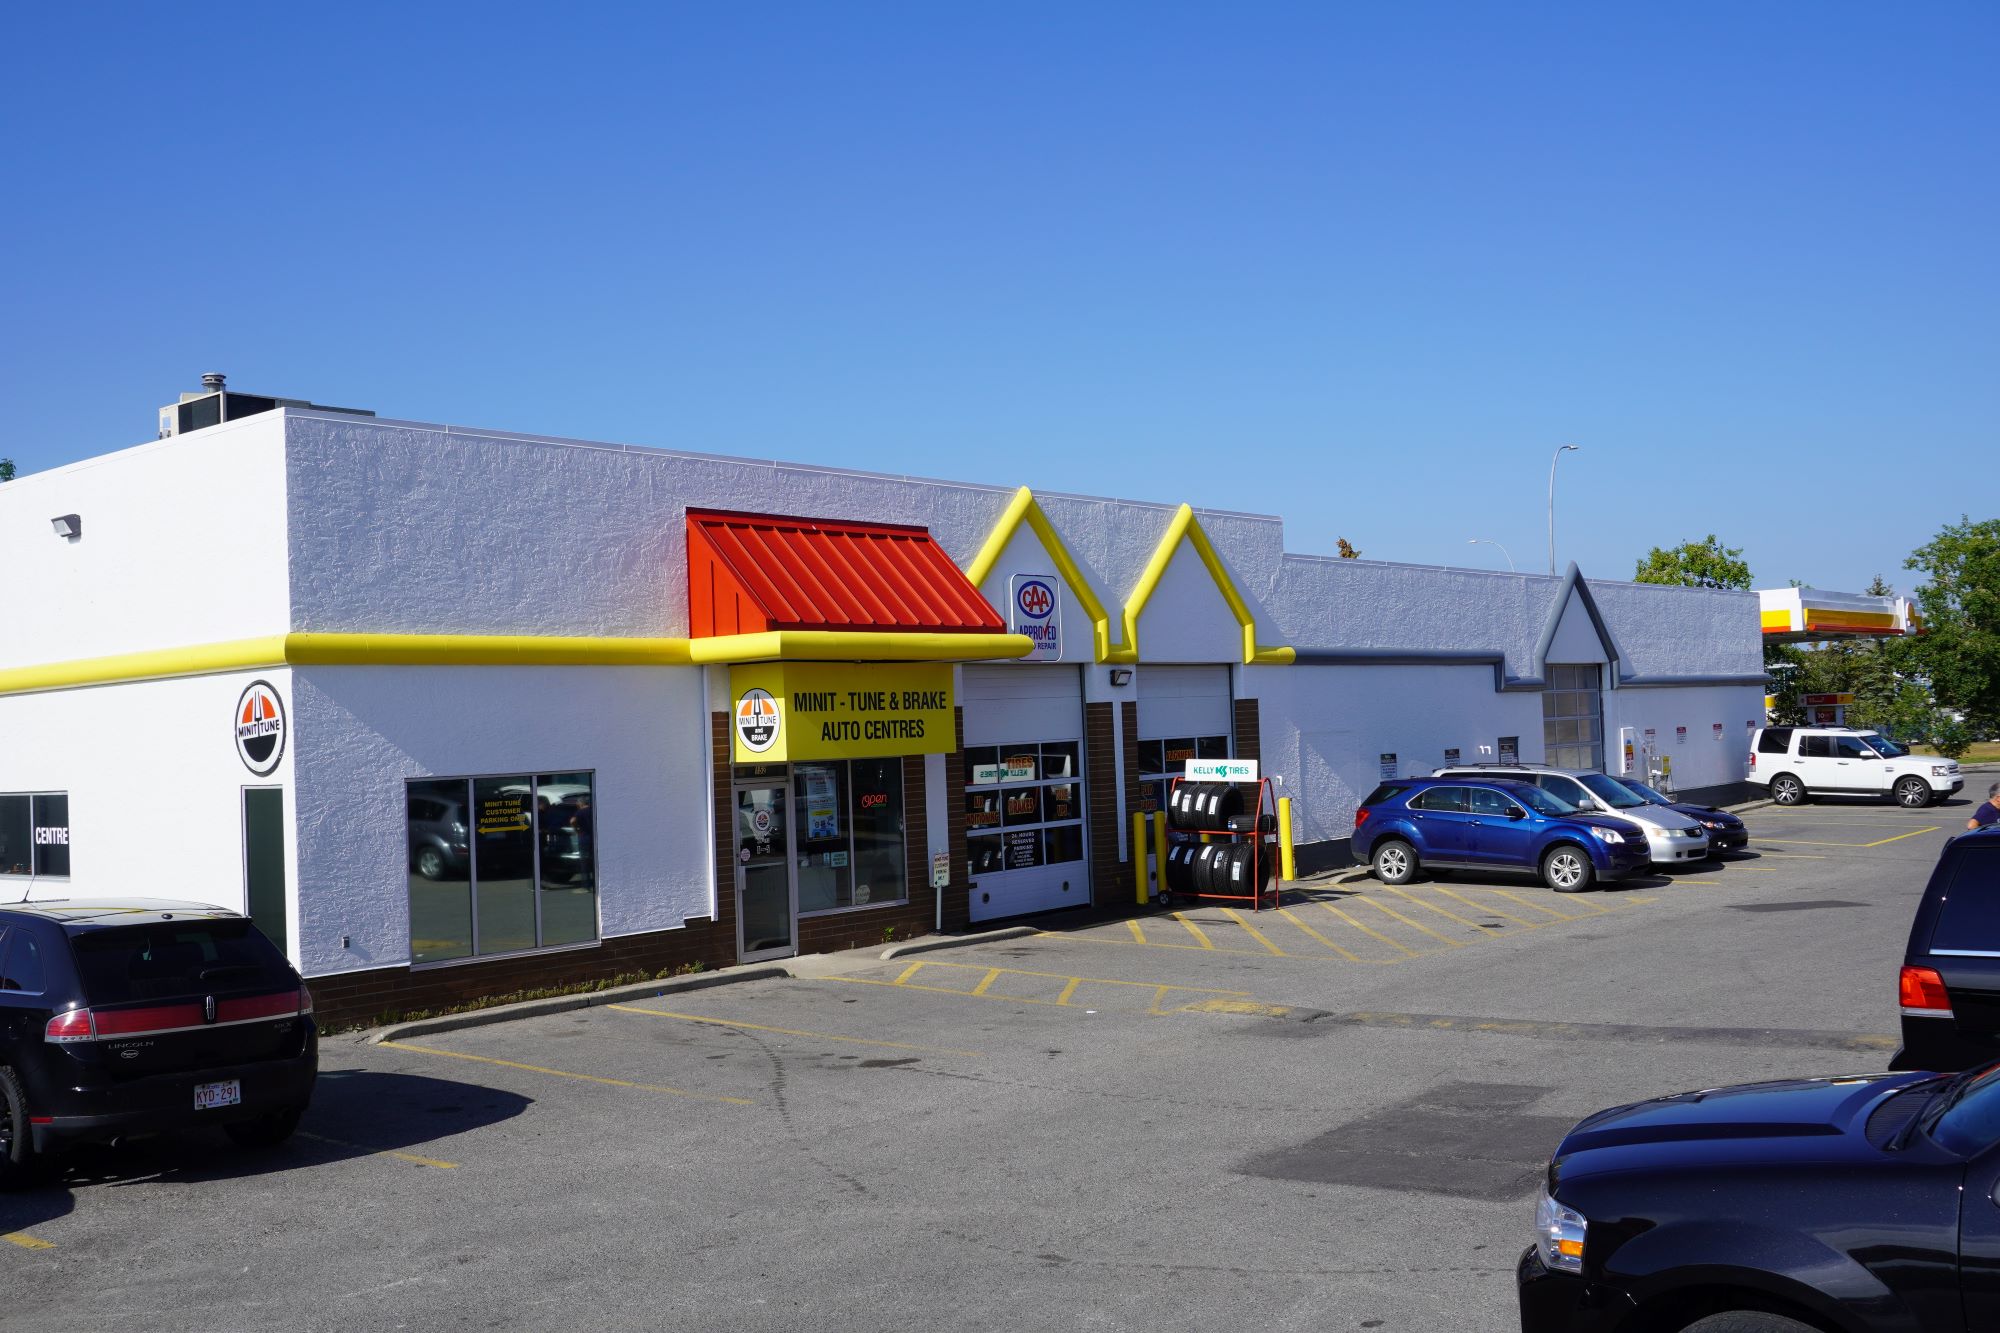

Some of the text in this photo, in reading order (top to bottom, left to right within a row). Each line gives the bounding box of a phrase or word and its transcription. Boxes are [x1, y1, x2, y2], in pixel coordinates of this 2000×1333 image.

[1022, 586, 1050, 613] CAA
[1020, 625, 1056, 640] APPROVED
[1037, 642, 1057, 650] REPAIR
[794, 692, 836, 712] MINIT
[848, 692, 886, 711] TUNE
[889, 692, 899, 710] &
[903, 691, 947, 710] BRAKE
[738, 715, 777, 726] MINIT TUNE
[238, 719, 280, 738] MINIT TUNE
[821, 719, 925, 741] AUTO CENTRES
[751, 734, 768, 742] BRAKE
[1006, 756, 1034, 769] TIRES
[1193, 766, 1214, 775] KELLY
[1229, 766, 1249, 775] TIRES
[861, 793, 887, 808] Open
[35, 826, 69, 845] CENTRE
[108, 1041, 154, 1050] LINCOLN
[196, 1086, 237, 1103] KYD-291
